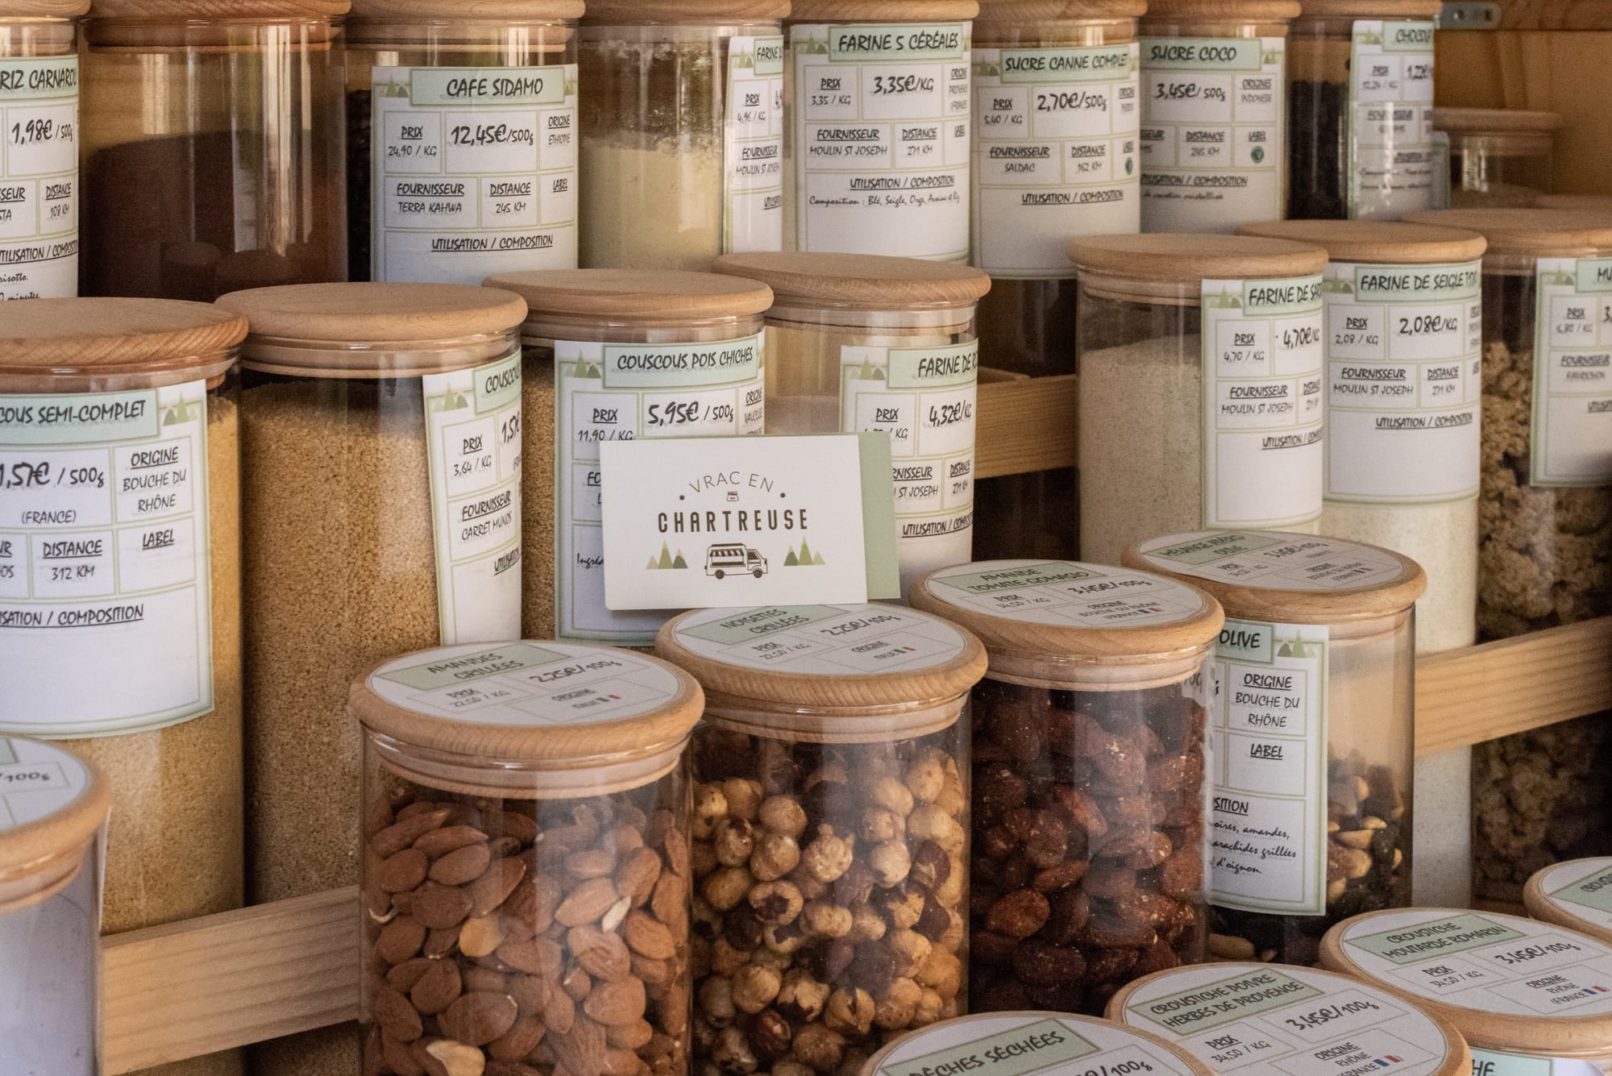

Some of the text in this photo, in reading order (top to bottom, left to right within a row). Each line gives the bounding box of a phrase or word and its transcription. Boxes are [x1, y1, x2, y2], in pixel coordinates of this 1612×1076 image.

[839, 34, 891, 52] FARINE
[909, 30, 958, 50] CÉRÉALES
[1151, 45, 1237, 61] SUCRE COCO
[1005, 56, 1089, 71] SUCRE CANNE
[0, 69, 24, 90] RIZ
[447, 78, 543, 97] CAFE SIDAMO
[820, 78, 841, 90] PRIX
[873, 76, 934, 95] 3,35€/KG
[12, 119, 52, 145] 1,98€
[401, 125, 423, 139] PRIX
[451, 124, 534, 146] 12,45€/500g
[817, 127, 938, 141] FOURNISSEUR DISTANCE
[388, 145, 438, 157] 24,90 KG
[990, 147, 1050, 159] FOURNISSEUR
[46, 183, 71, 200] DISTANCE
[397, 182, 465, 197] FOURNISSEUR
[490, 182, 531, 197] DISTANCE
[850, 178, 901, 191] UTILISATION
[398, 201, 462, 213] TERRA KAHWA
[432, 235, 553, 252] UTILISATION COMPOSITION
[1361, 275, 1410, 290] FARINE
[1414, 275, 1430, 290] DE
[1248, 285, 1309, 305] FARINE DE
[1346, 317, 1368, 330] PRIX
[1400, 315, 1458, 336] 2,08€/KG
[1234, 333, 1255, 346] PRIX
[617, 346, 753, 371] COUSCOUS POIS CHICHES
[918, 357, 960, 377] FARINE
[1341, 367, 1459, 380] FOURNISSEUR DISTANCE
[1230, 385, 1288, 400] FOURNISSEUR
[1333, 385, 1368, 394] MOULIN
[1381, 385, 1414, 395] JOSEPH
[38, 400, 146, 424] SEMI-COMPLET
[592, 408, 617, 424] PRIX
[648, 401, 734, 426] 5,95€ 500g
[875, 408, 899, 422] PRIX
[1221, 404, 1256, 414] MOULIN
[1375, 417, 1426, 430] UTILISATION
[577, 429, 606, 443] 11,90
[896, 428, 909, 440] KG
[1262, 434, 1302, 450] UTILISATION
[462, 434, 483, 454] PRIX
[130, 446, 179, 469] ORIGINE
[453, 455, 492, 477] 3,64 KG
[69, 467, 104, 488] 500g
[123, 469, 187, 492] BOUCHE DU
[689, 471, 774, 493] VRAC EN
[899, 485, 939, 498] ST JOSEPH
[137, 493, 177, 512] RHÔNE
[461, 490, 511, 522] FOURNISSEUR
[21, 509, 77, 525] (FRANCE)
[658, 509, 807, 533] CHARTREUSE
[461, 519, 492, 541] CARRET
[901, 520, 947, 538] UTILISATION
[42, 528, 175, 559] DISTANCE LABEL
[51, 565, 95, 581] 312 KM
[58, 604, 144, 625] COMPOSITION
[1219, 630, 1261, 648] OLIVE
[427, 652, 503, 674] AMANDES
[1243, 673, 1292, 690] ORIGINE
[1235, 692, 1300, 708] BOUCHE DU
[1248, 713, 1287, 728] RHÔNE
[1250, 743, 1283, 760] LABEL
[1243, 827, 1290, 840] amandes,
[1212, 841, 1258, 855] arachides
[1386, 922, 1463, 944] CROUSTICHE
[1382, 926, 1508, 959] MOUTARDE ROMARIN
[1150, 972, 1277, 1016] CROUSTICHE POIVRE
[1163, 981, 1305, 1030] HERBES DE PROVENCE
[1285, 999, 1381, 1032] 3,45€/100g
[984, 1030, 1065, 1063] SÉCHÉES
[1204, 1034, 1242, 1051] PRIX
[1252, 1040, 1272, 1051] KG
[1314, 1041, 1362, 1062] ORIGINE
